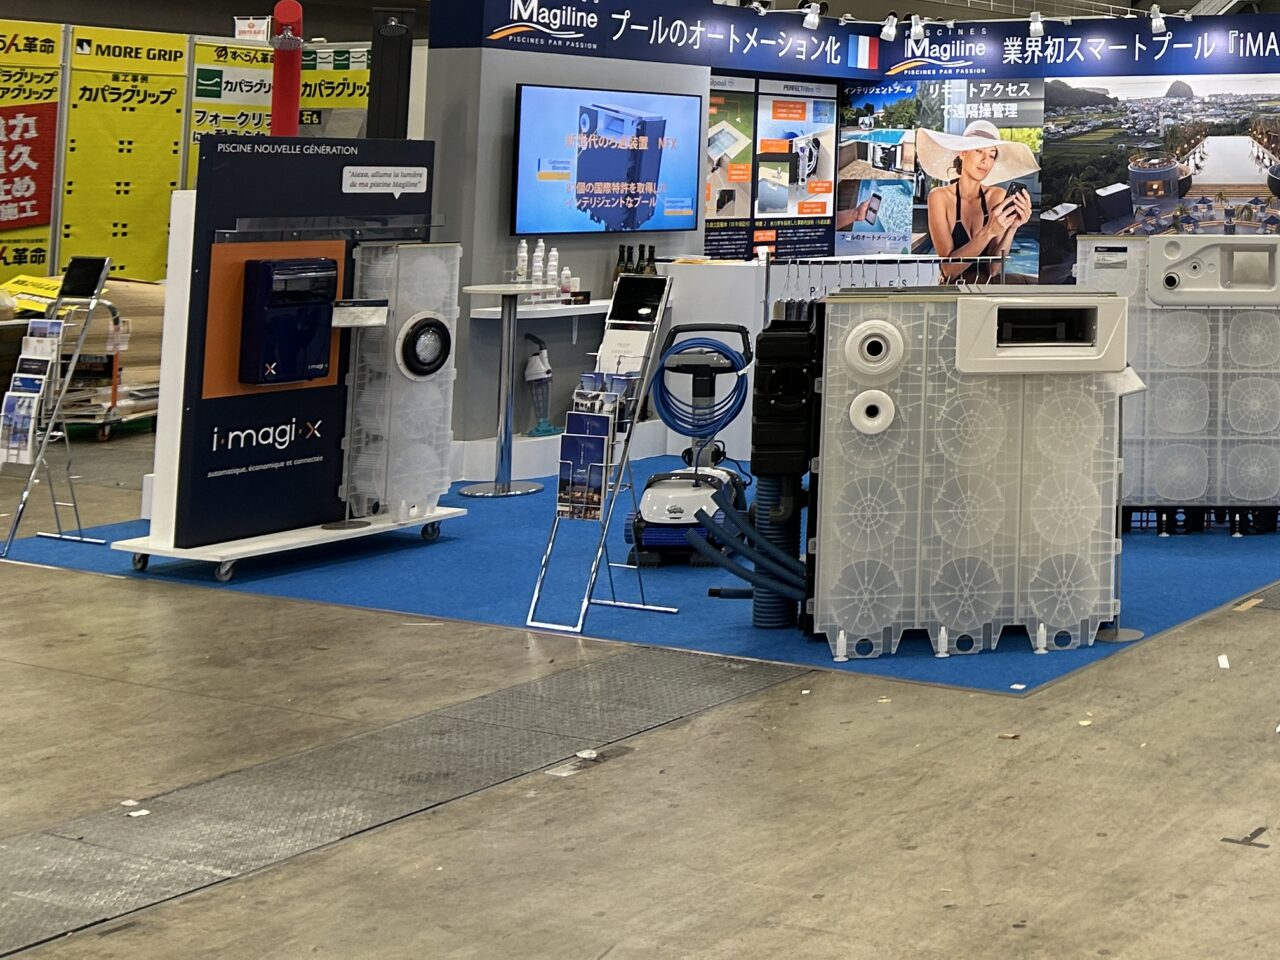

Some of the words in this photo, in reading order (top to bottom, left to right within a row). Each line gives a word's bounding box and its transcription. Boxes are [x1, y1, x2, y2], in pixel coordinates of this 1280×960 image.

[611, 9, 841, 64] プールのオートメーション化
[905, 27, 987, 36] PSCINES
[508, 35, 545, 44] PISCINES
[548, 39, 563, 47] PAR
[566, 40, 597, 49] PASSION
[95, 43, 143, 60] MORE
[146, 48, 184, 62] GRIP
[0, 69, 59, 84] ラグリップ
[78, 85, 177, 105] カパラグリップ
[929, 83, 1031, 98] リモートアクセス
[217, 143, 252, 153] PISCINE
[254, 143, 301, 154] NOUVELLE
[303, 143, 358, 155] GÉNÉRATION
